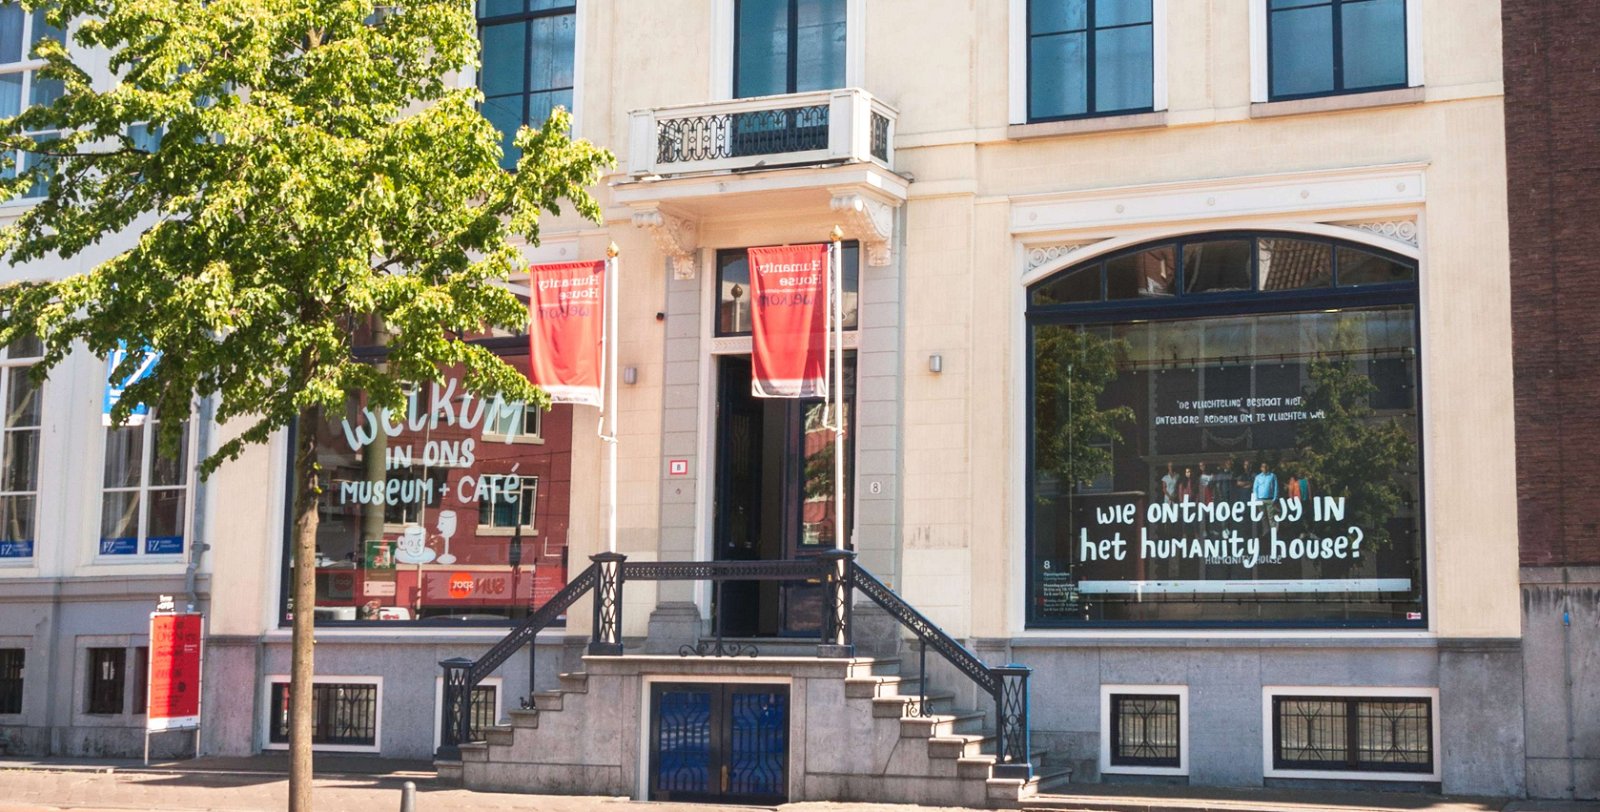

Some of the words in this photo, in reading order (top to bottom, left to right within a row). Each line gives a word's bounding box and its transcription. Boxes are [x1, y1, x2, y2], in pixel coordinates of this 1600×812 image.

[1240, 413, 1253, 422] OM
[386, 445, 412, 471] IN
[423, 438, 476, 468] ONS
[438, 482, 450, 496] +
[872, 482, 879, 492] 8
[1313, 496, 1345, 522] IN
[1080, 527, 1127, 562] het
[1043, 560, 1050, 569] 8
